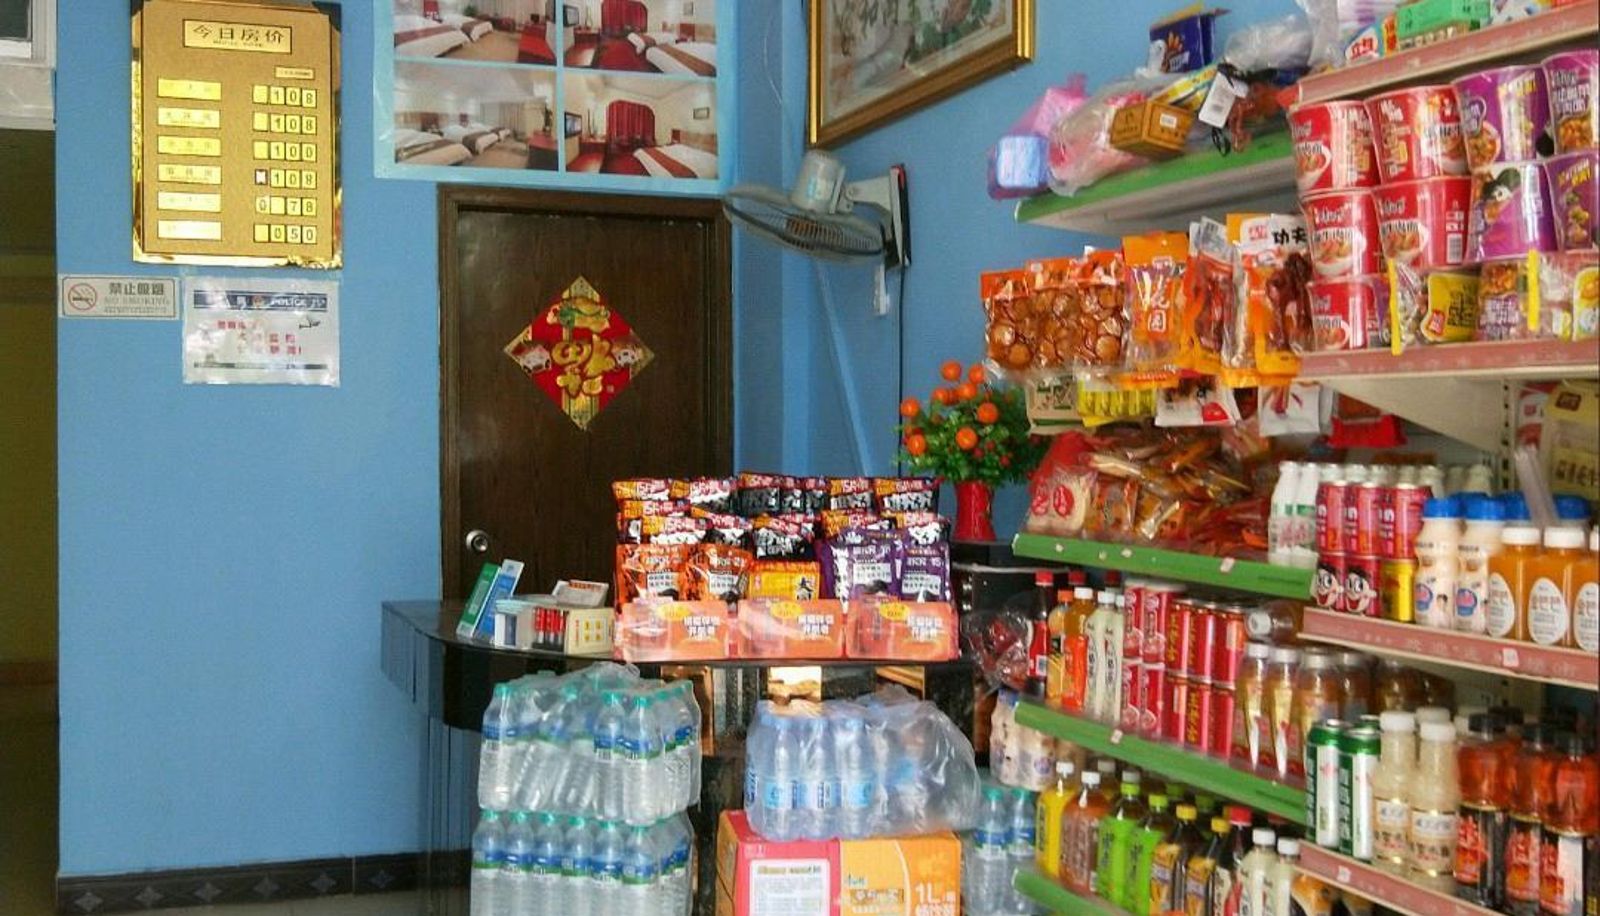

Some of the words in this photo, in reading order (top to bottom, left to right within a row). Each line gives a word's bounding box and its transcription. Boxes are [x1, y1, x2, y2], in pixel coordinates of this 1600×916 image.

[193, 24, 284, 44] 今日房价
[274, 88, 314, 105] 108
[274, 115, 314, 131] 108
[274, 172, 314, 187] 108
